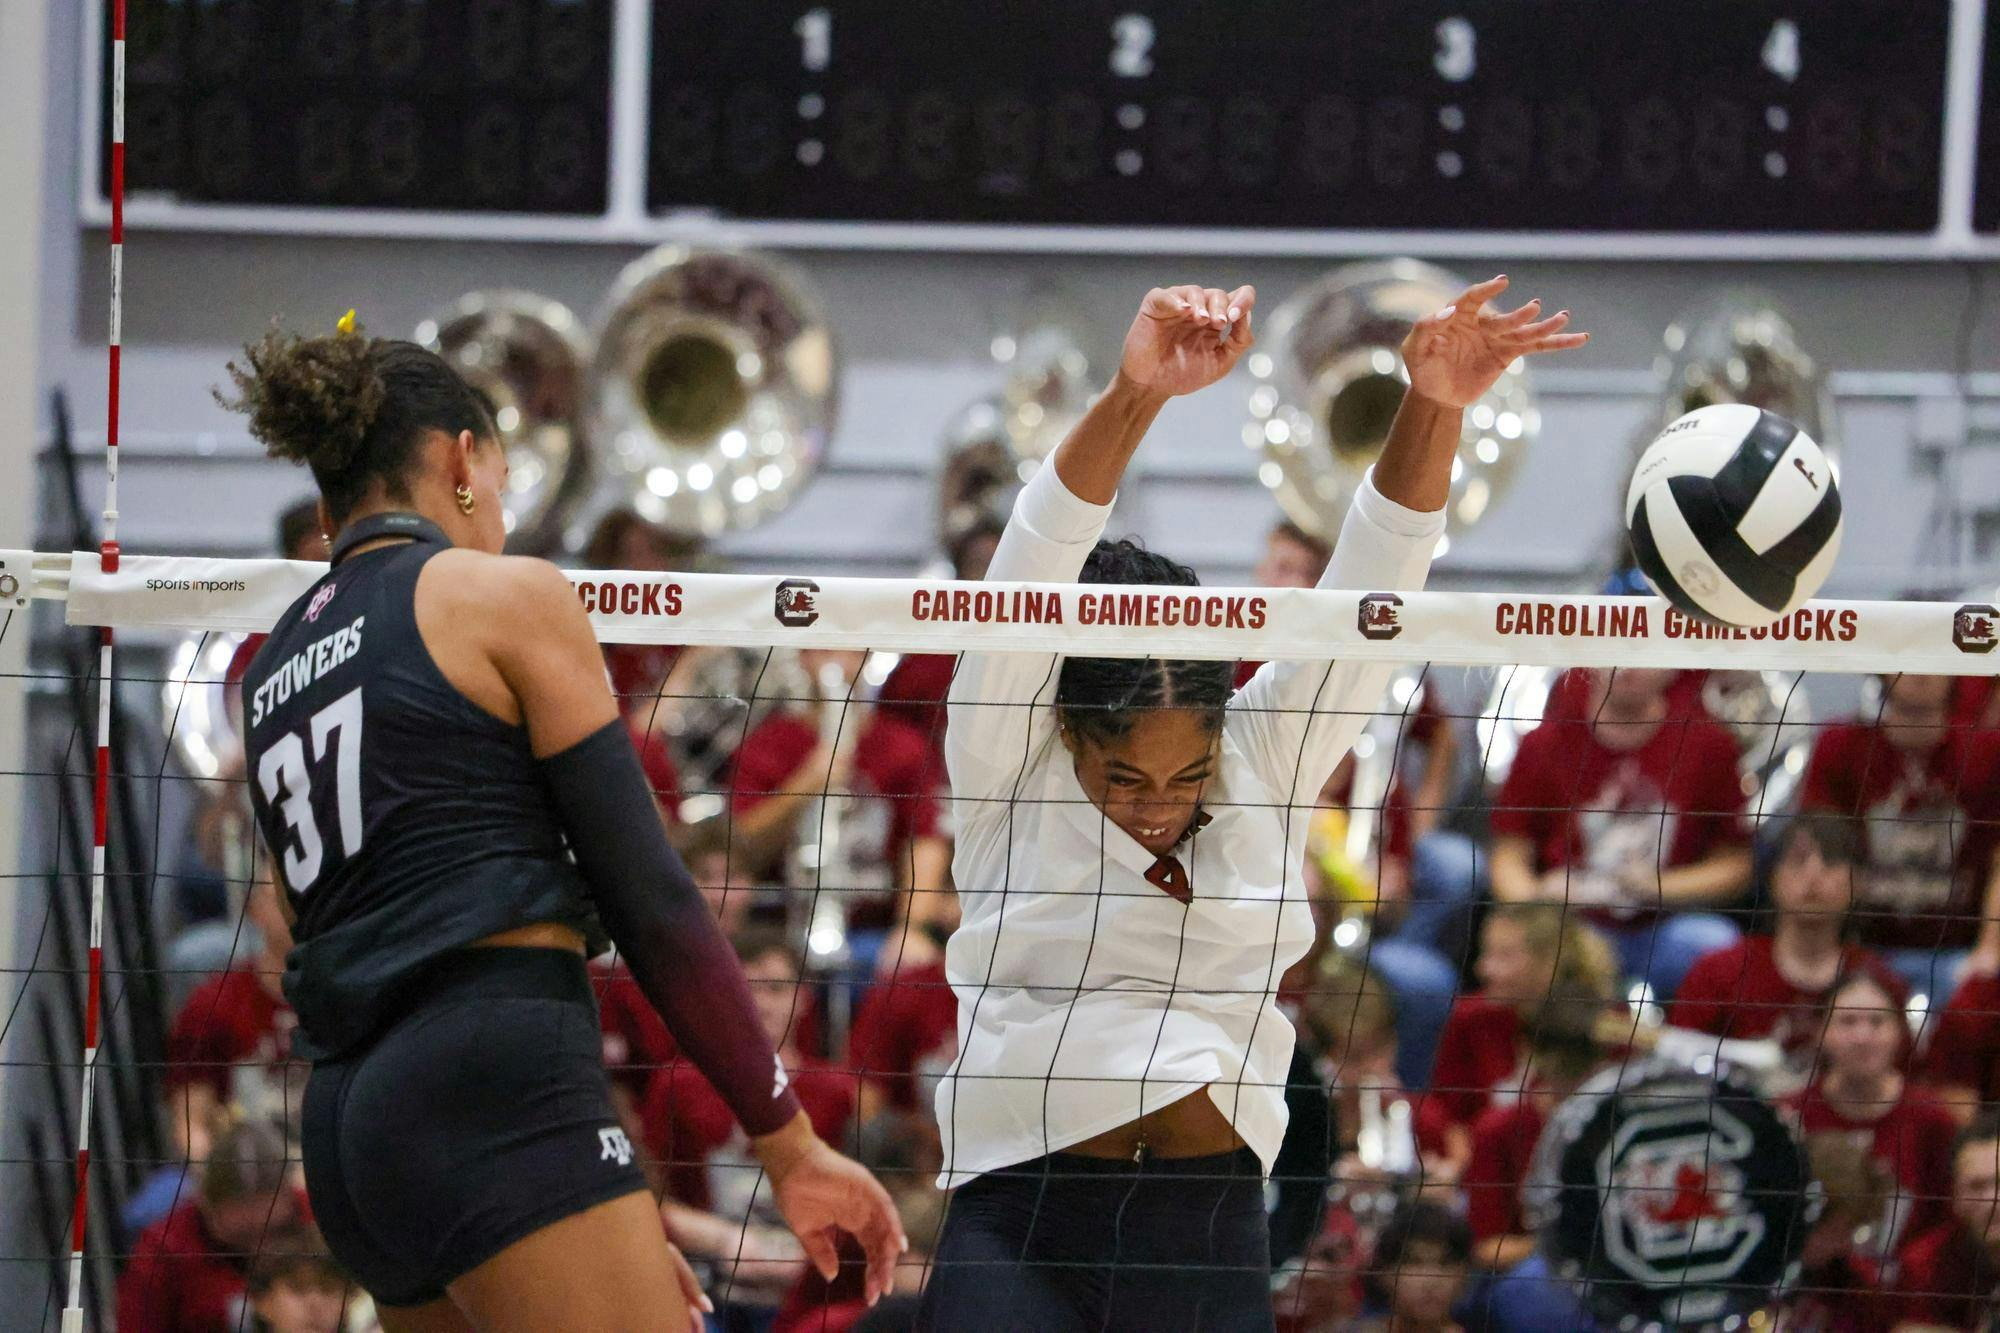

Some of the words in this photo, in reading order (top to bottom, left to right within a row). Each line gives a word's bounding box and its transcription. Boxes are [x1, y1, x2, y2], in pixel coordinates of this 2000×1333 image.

[795, 8, 832, 71] 1
[1109, 14, 1155, 77] 2
[1434, 18, 1477, 82] 3
[1762, 18, 1802, 82] 4
[146, 579, 190, 592] sports
[192, 580, 246, 592] imports
[912, 589, 1063, 625] CAROLINA
[1078, 594, 1267, 630] GAMECOCKS
[1495, 603, 1649, 638] CAROLINA
[252, 616, 366, 729] STOWERS
[258, 685, 364, 893] 37
